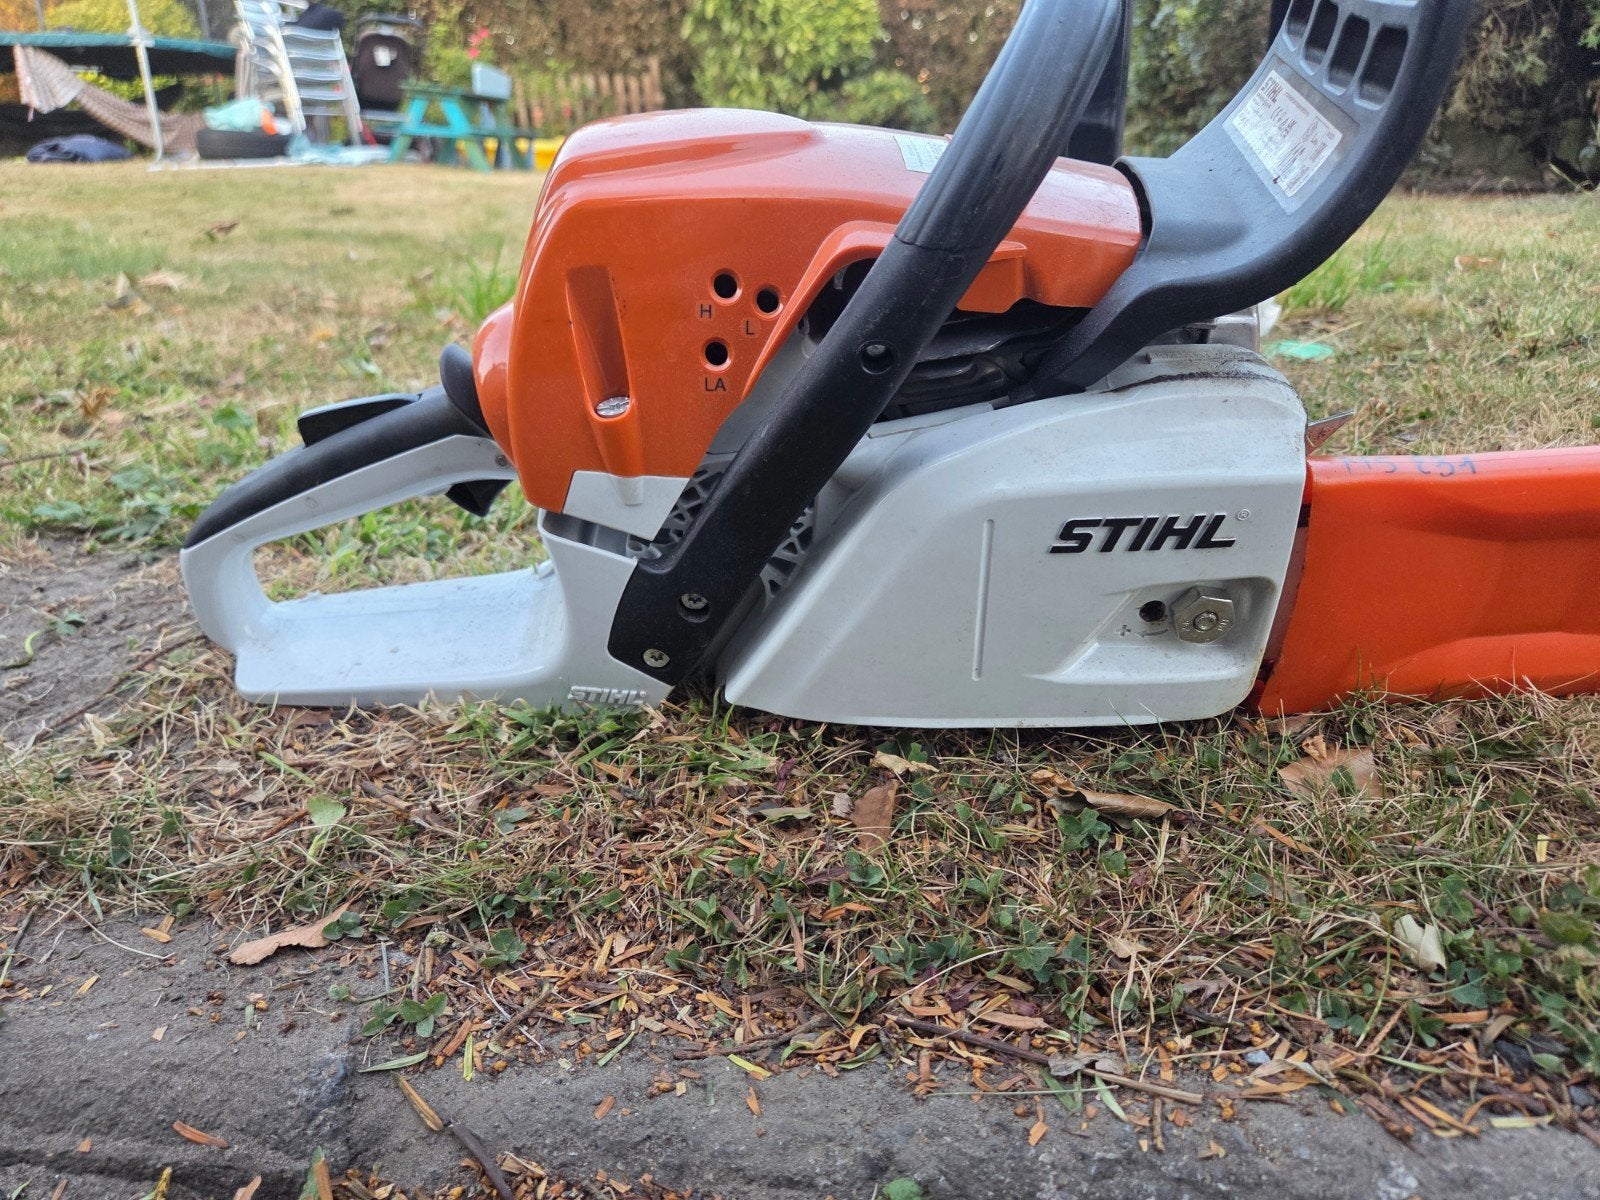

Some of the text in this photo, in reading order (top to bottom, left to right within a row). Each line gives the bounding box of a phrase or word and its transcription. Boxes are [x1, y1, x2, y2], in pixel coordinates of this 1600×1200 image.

[1260, 77, 1283, 103] STIHL
[700, 304, 712, 318] H
[745, 321, 755, 335] L
[705, 378, 726, 392] LA
[1049, 513, 1236, 553] STIHL
[568, 686, 643, 704] STIHL
